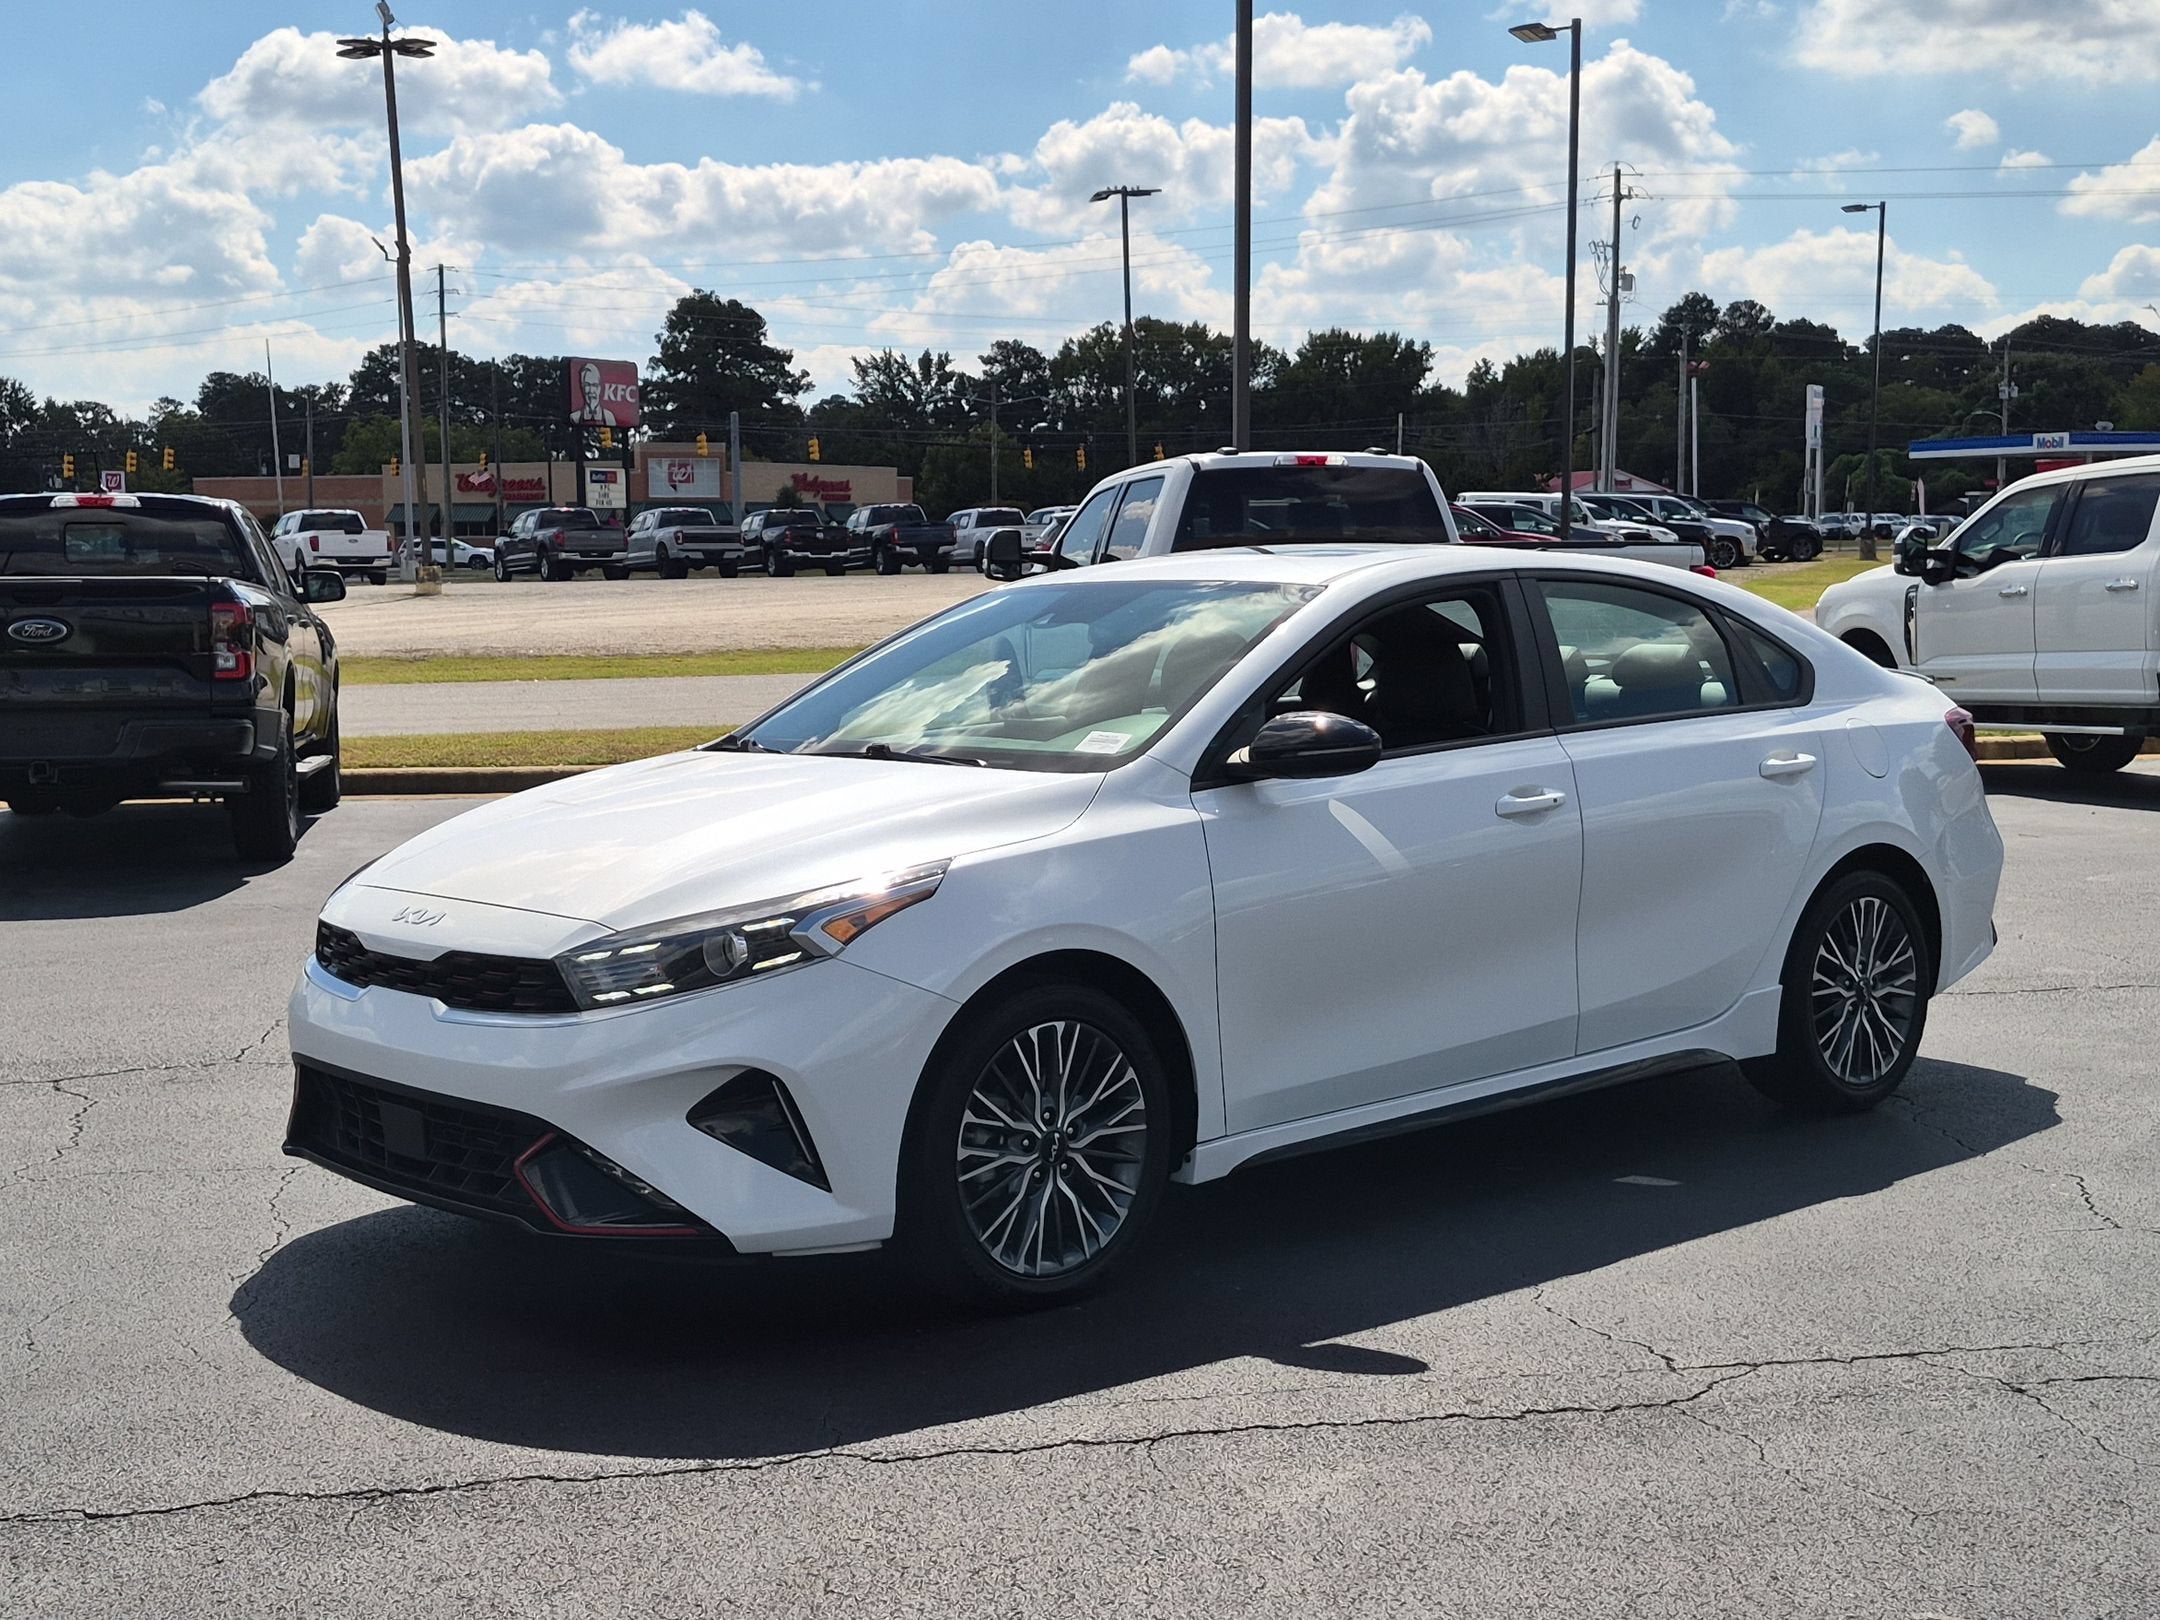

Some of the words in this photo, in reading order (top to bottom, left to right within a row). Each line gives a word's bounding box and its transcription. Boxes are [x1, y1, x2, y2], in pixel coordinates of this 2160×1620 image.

[603, 382, 637, 403] KFC
[2036, 436, 2064, 449] Mobil
[22, 623, 53, 637] Ford
[391, 904, 448, 927] KIA
